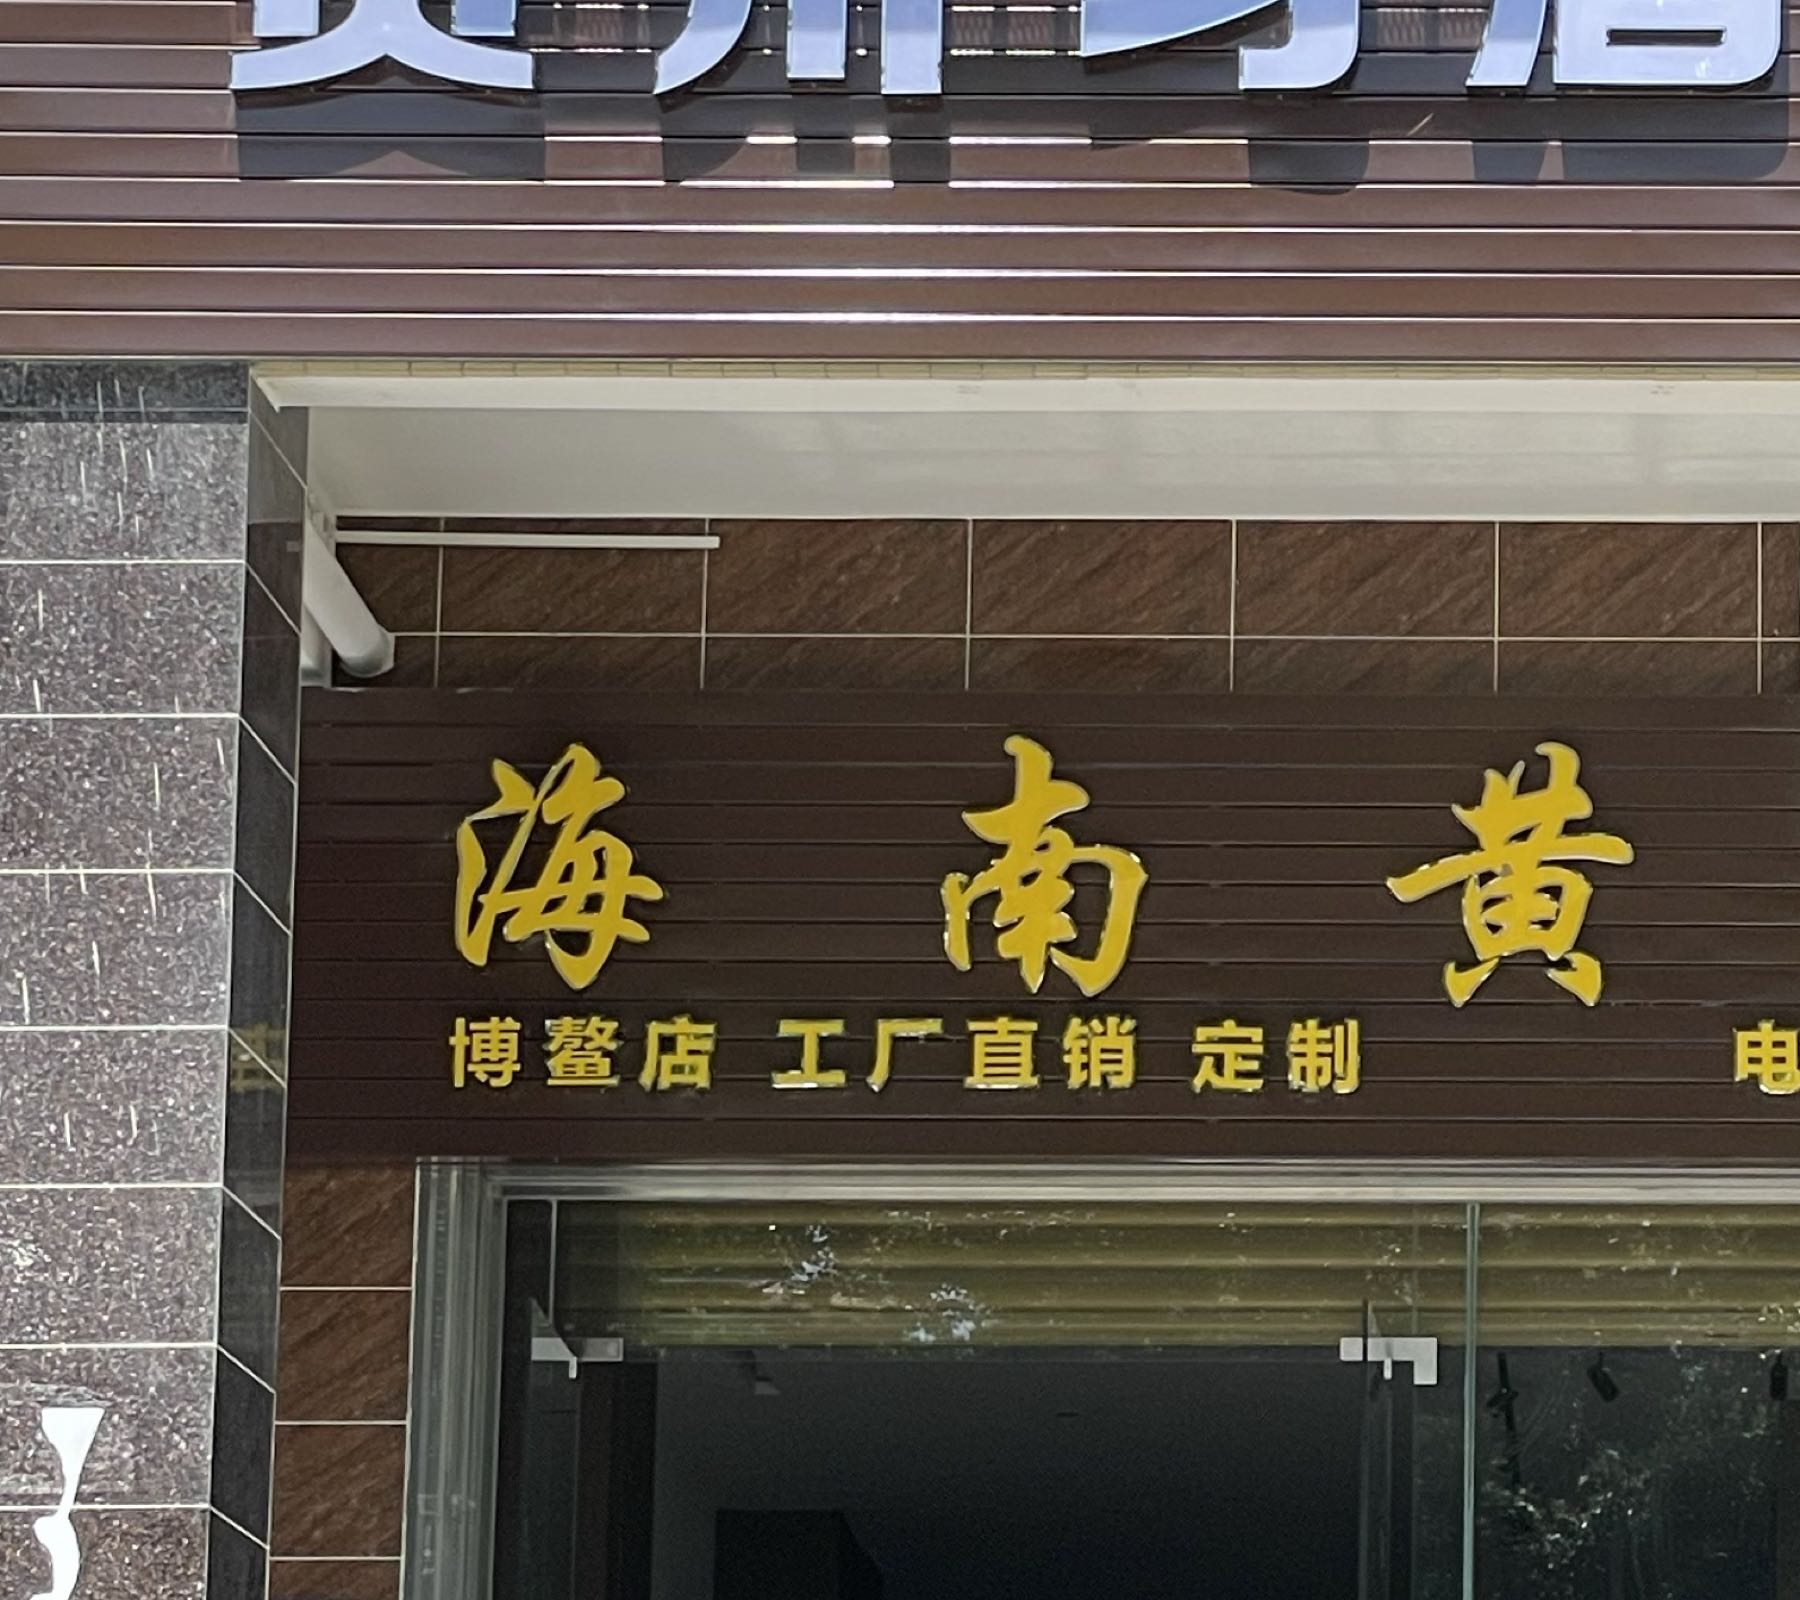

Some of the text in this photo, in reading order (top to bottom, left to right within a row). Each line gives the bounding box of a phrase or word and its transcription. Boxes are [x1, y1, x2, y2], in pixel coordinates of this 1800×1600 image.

[447, 1014, 1363, 1093] 博鳌店 工厂直销 定制
